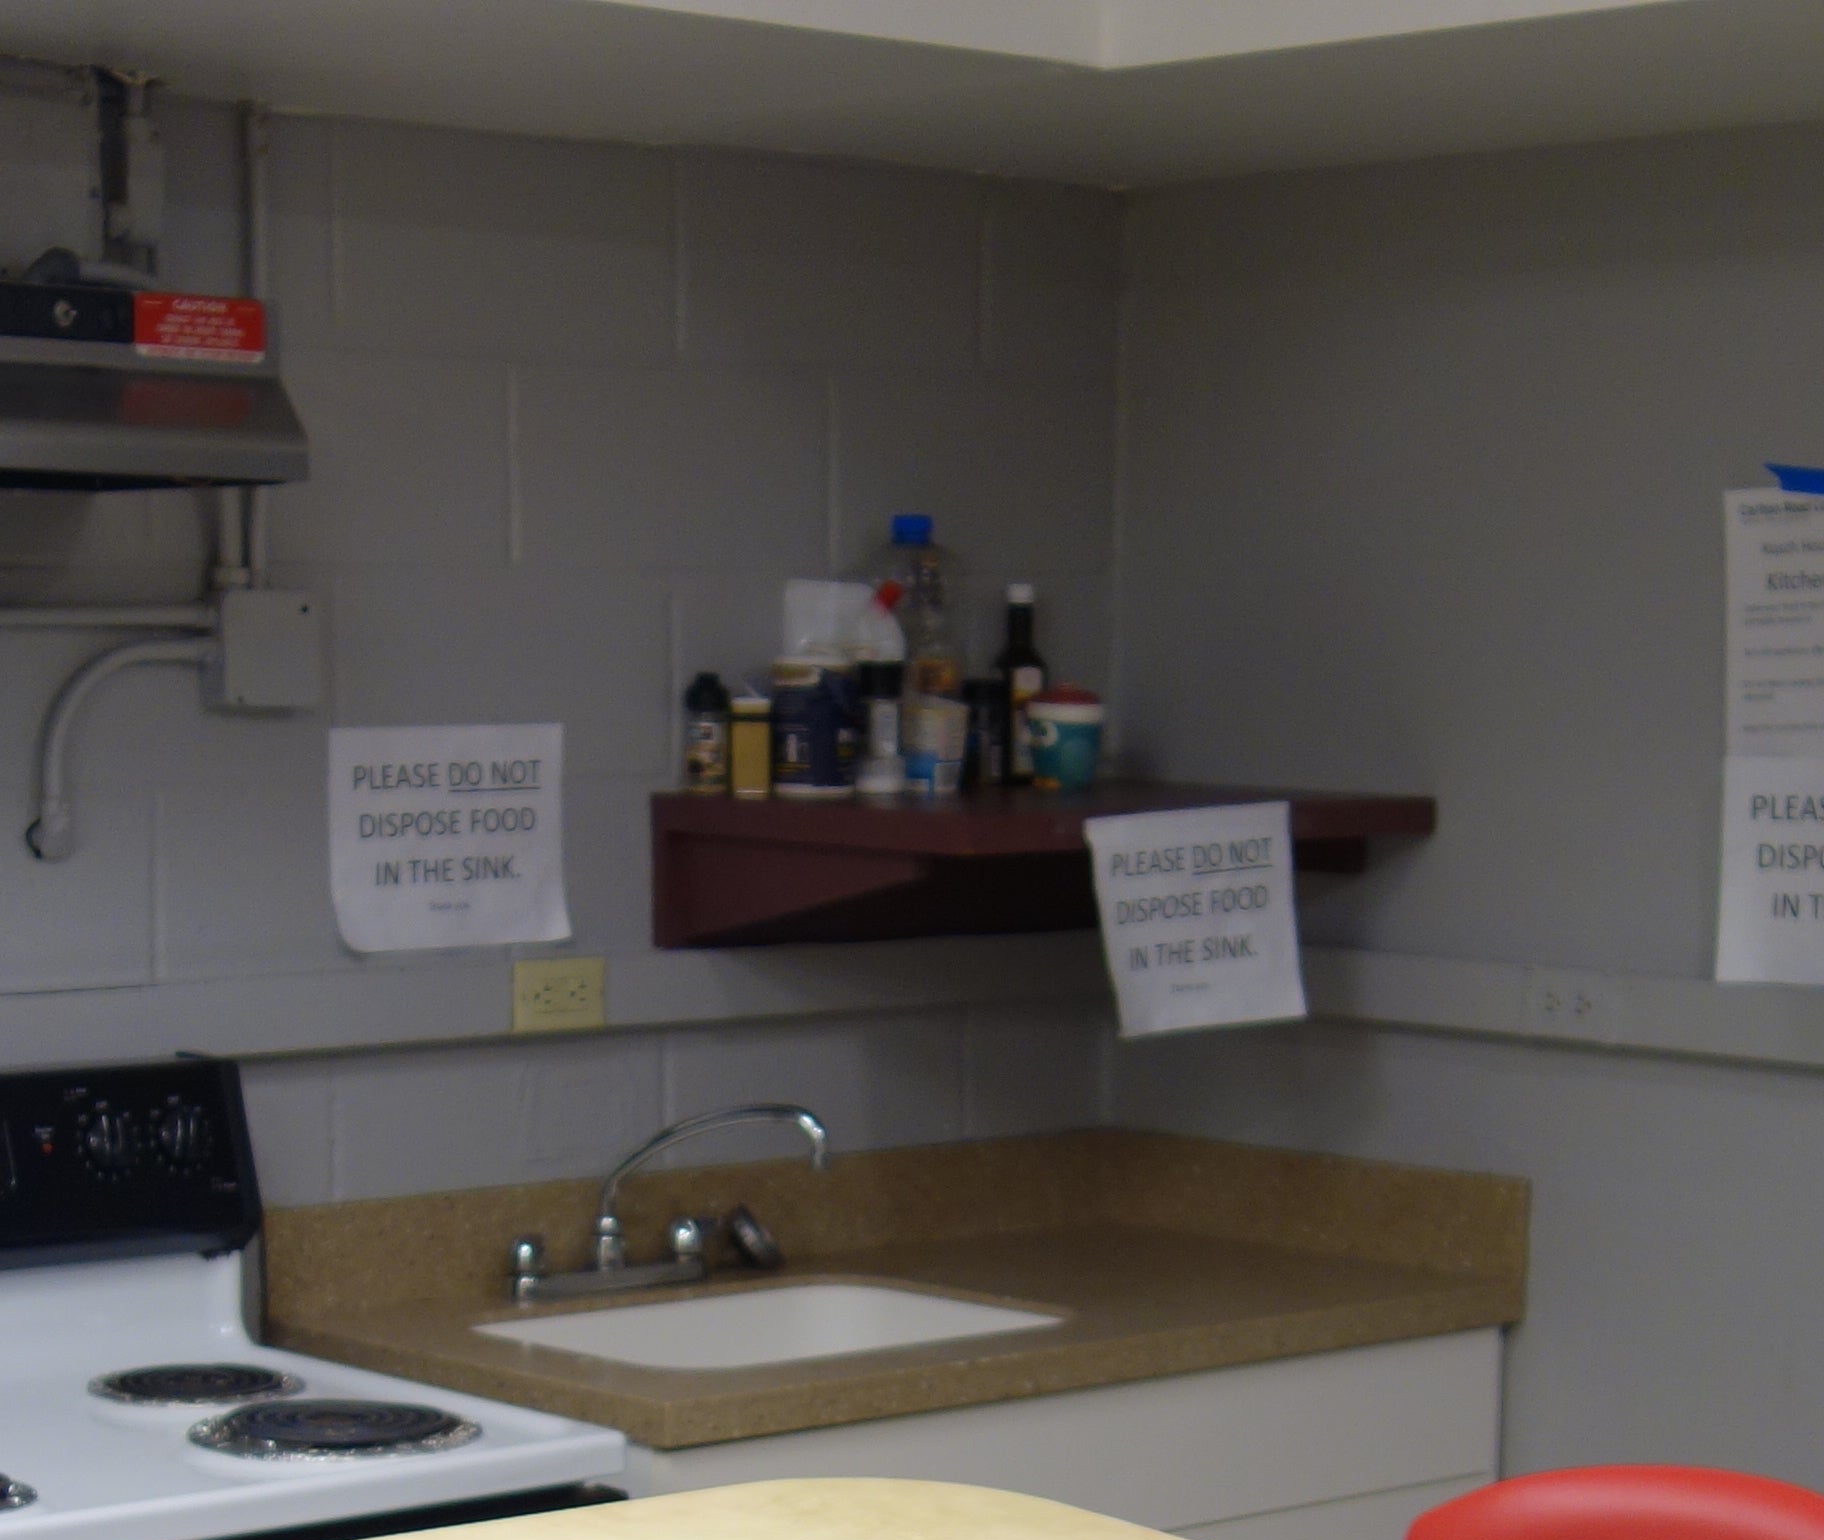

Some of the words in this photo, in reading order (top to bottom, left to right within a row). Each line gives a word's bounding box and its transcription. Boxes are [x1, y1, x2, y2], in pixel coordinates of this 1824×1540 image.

[352, 762, 441, 791] PLEASE
[447, 761, 483, 787] DO
[491, 759, 542, 785] NOT
[358, 809, 462, 840] DISPOSE
[470, 806, 537, 834] FOOD
[374, 860, 400, 886] IN
[407, 857, 456, 884] THE
[461, 854, 522, 882] SINK.
[1111, 846, 1185, 877] PLEASE
[1191, 843, 1223, 868] DO
[1229, 836, 1273, 864] NOT
[1116, 891, 1204, 925] DISPOSE
[1210, 884, 1270, 914] FOOD
[1772, 892, 1800, 919] IN
[1129, 945, 1149, 970] IN
[1154, 939, 1195, 966] THE
[1201, 934, 1259, 962] SINK.
